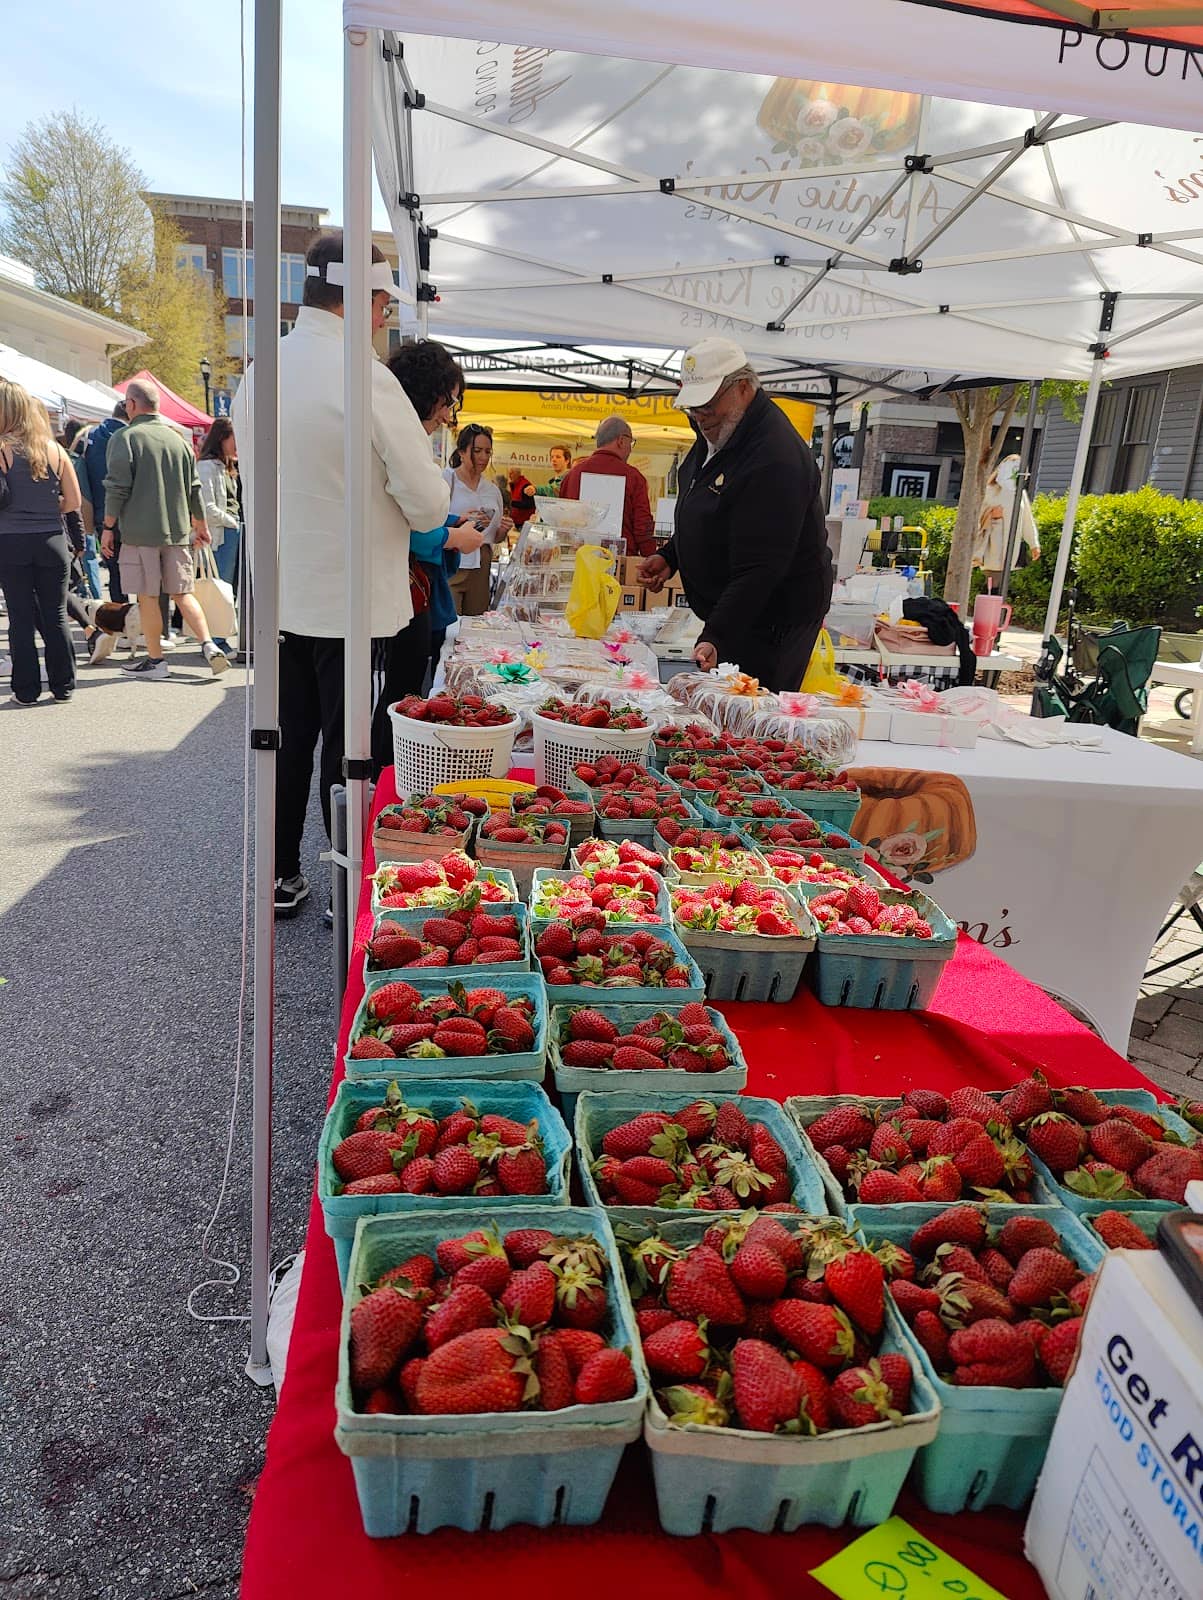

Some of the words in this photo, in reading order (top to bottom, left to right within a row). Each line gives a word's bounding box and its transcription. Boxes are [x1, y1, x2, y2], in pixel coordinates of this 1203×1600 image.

[511, 452, 549, 463] Antoni
[1107, 1335, 1168, 1430] Get
[1095, 1368, 1134, 1443] FOOD
[1137, 1442, 1203, 1560] STORA
[898, 1541, 984, 1600] 8.0
